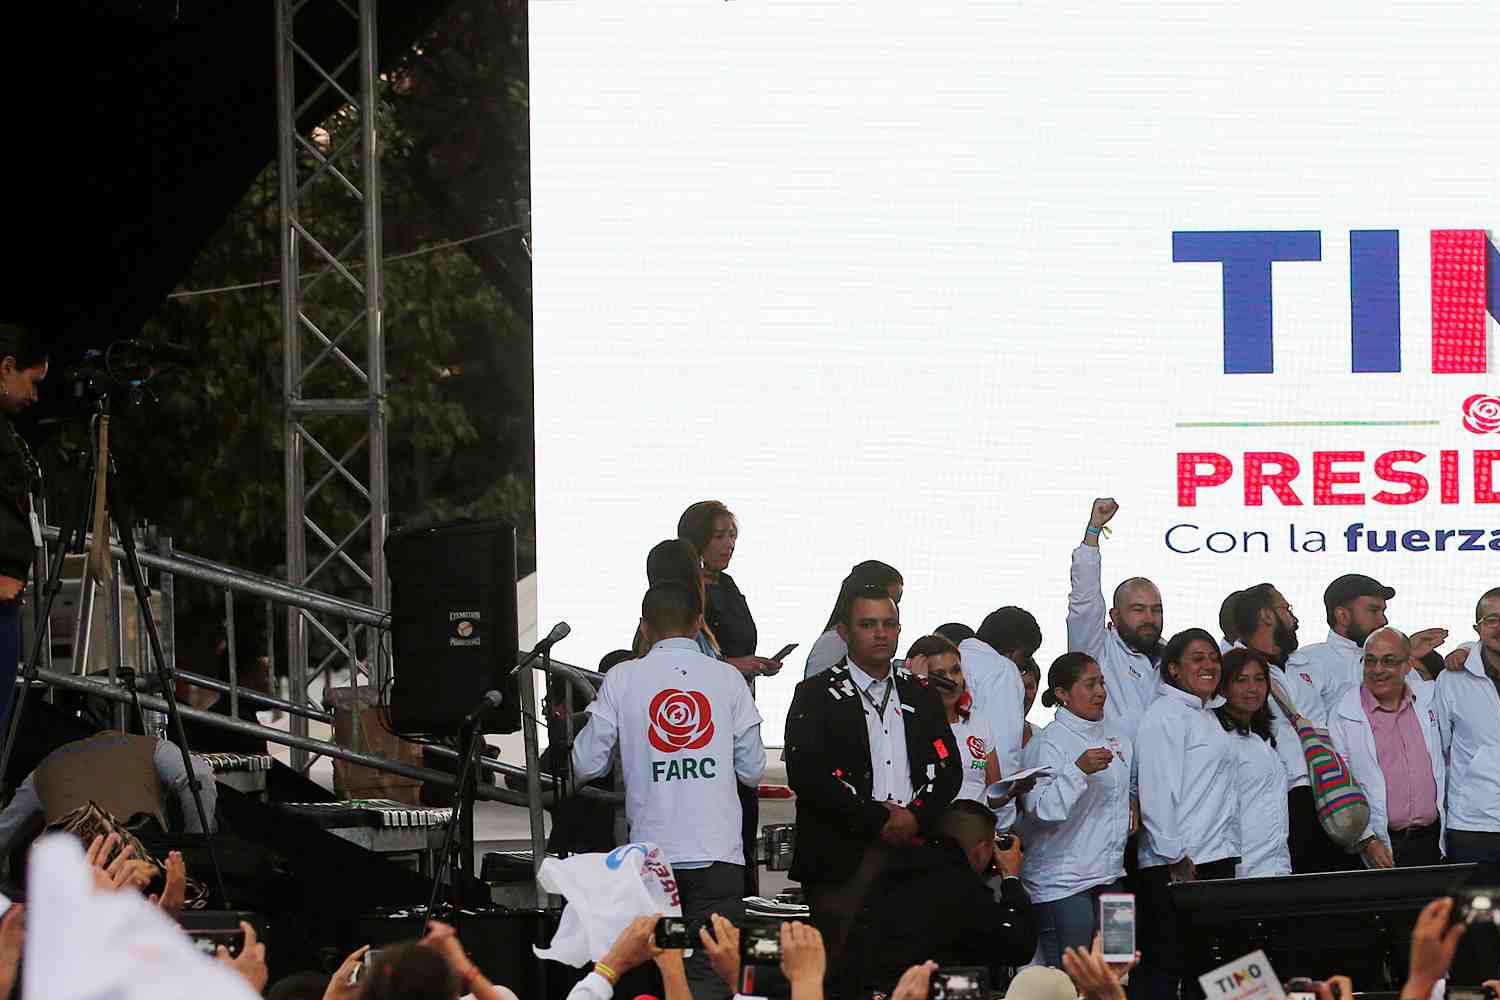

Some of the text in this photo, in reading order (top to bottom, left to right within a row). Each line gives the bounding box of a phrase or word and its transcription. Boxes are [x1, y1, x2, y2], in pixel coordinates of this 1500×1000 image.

[1165, 523, 1269, 554] Con
[1289, 523, 1326, 553] la
[652, 757, 716, 782] FARC
[1215, 963, 1262, 993] TIMO
